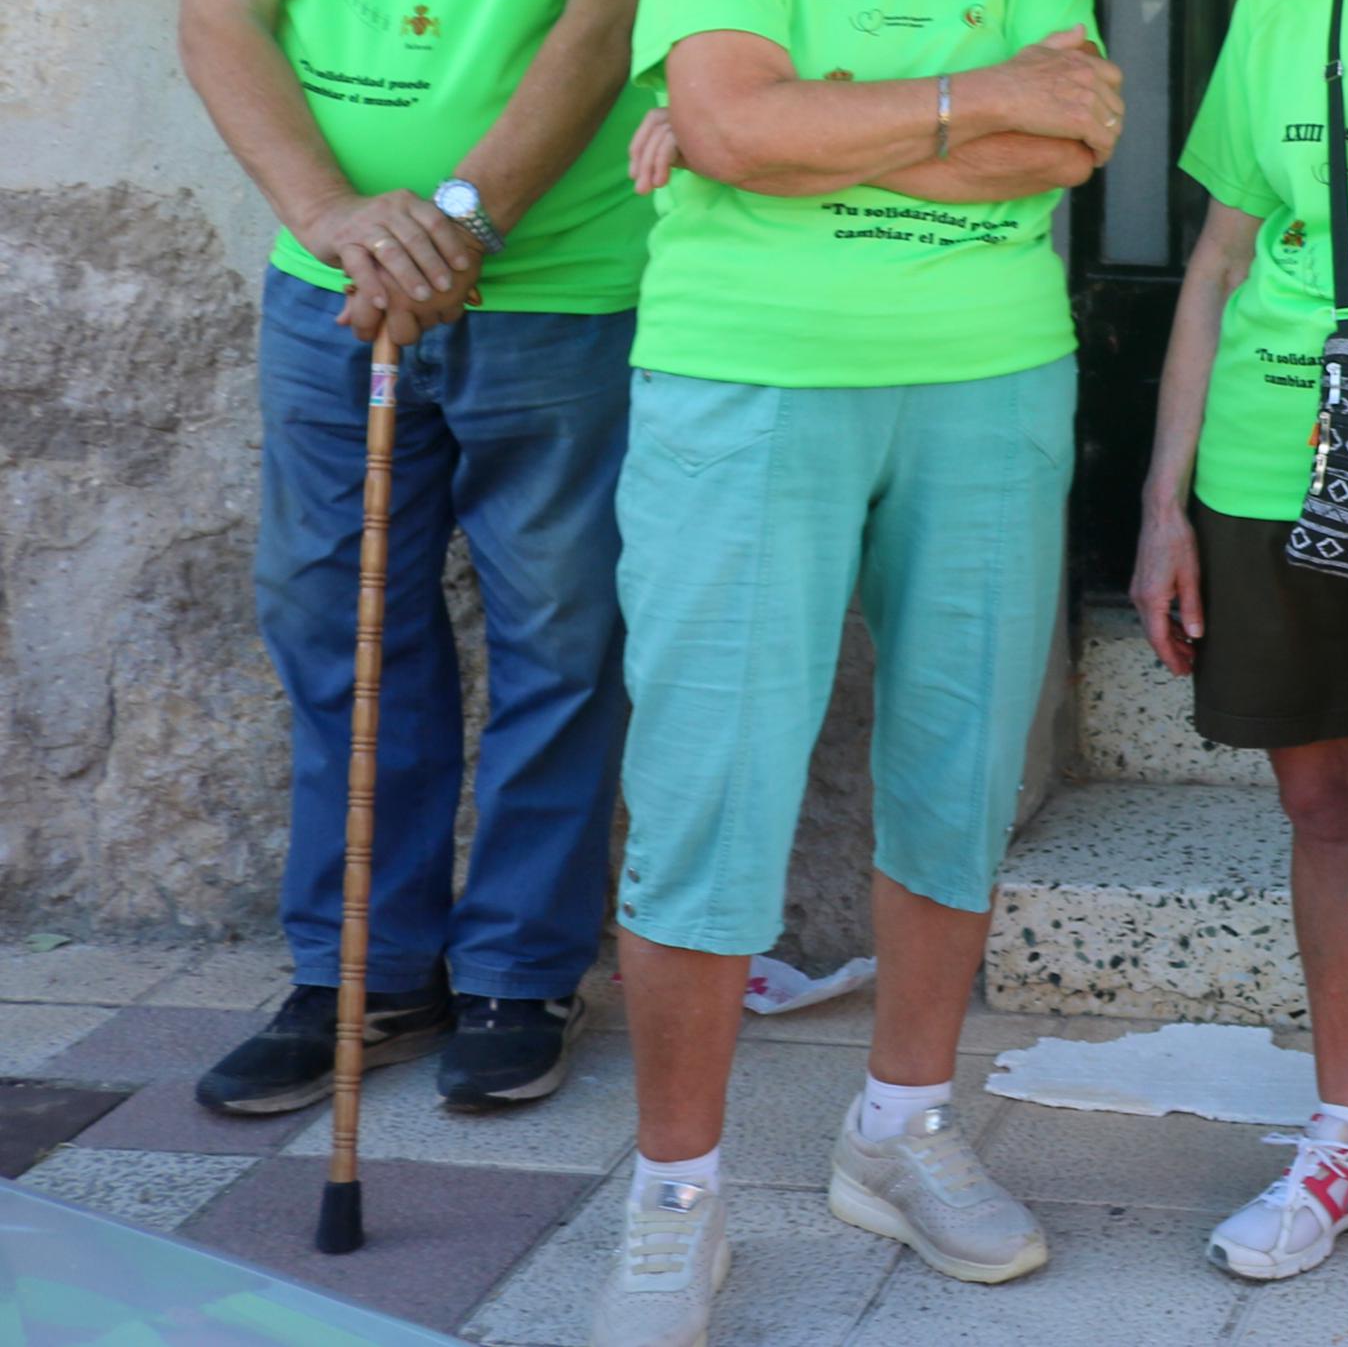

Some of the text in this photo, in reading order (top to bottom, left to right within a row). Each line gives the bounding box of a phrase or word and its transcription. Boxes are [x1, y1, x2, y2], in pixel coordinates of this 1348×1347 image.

[863, 206, 968, 229] solidaridad
[833, 226, 913, 241] cambiar
[918, 232, 934, 245] el
[1264, 373, 1316, 389] cambiar
